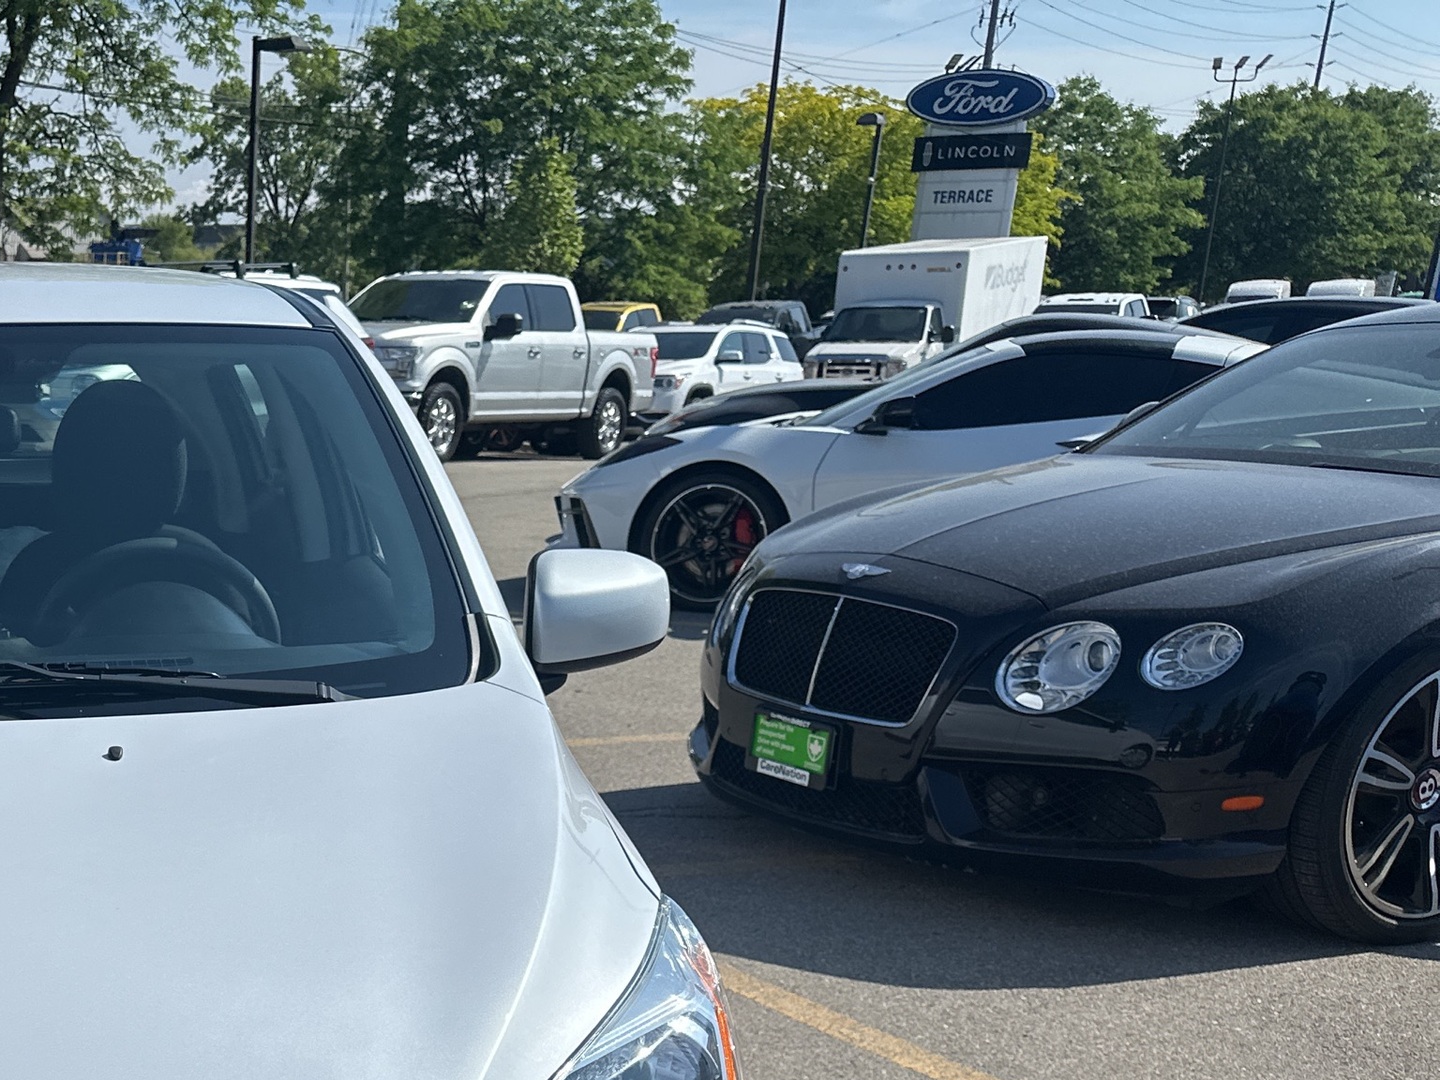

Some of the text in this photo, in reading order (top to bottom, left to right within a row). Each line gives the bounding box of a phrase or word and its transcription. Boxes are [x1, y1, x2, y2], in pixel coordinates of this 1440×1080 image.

[933, 79, 1019, 115] Ford
[937, 145, 1016, 160] LINCOLN
[933, 189, 994, 204] TERRACE
